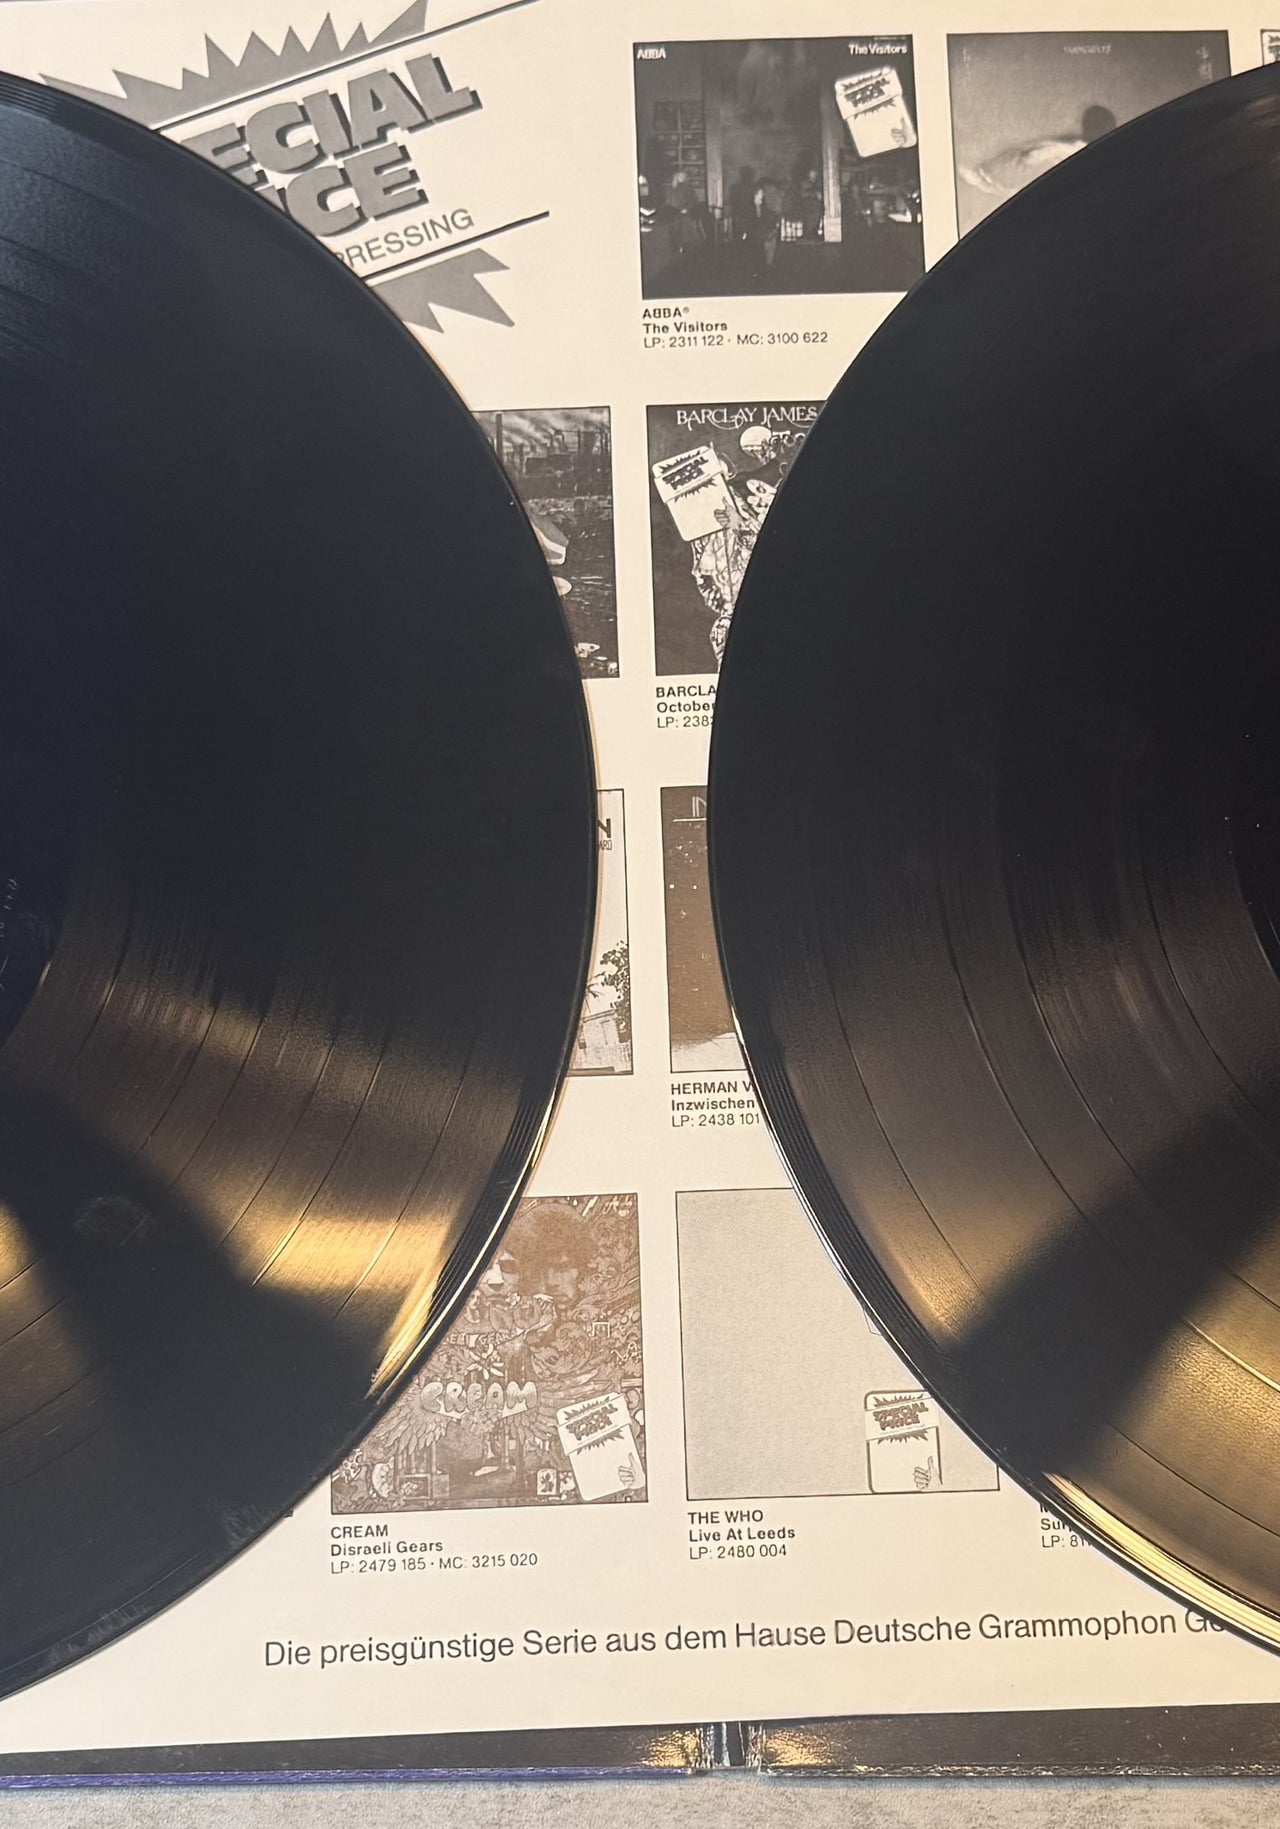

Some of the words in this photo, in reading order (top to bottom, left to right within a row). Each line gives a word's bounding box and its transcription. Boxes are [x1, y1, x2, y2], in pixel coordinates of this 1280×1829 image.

[180, 53, 483, 190] ECIAL
[643, 322, 669, 334] The
[674, 321, 728, 333] Visitors
[644, 337, 666, 349] LP:
[669, 336, 698, 347] 2311
[702, 335, 724, 346] 122
[737, 333, 764, 346] MC:
[767, 332, 799, 344] 3100
[803, 331, 828, 343] 622
[676, 406, 757, 431] BARCLAY
[656, 685, 717, 699] BARCLA
[657, 716, 679, 729] LP:
[671, 1082, 737, 1096] HERMAN
[671, 1096, 755, 1111] Inzwischen
[672, 1114, 695, 1127] LP:
[698, 1113, 735, 1126] 2438
[687, 1511, 720, 1524] THE
[725, 1510, 764, 1523] WHO
[331, 1525, 389, 1539] CREAM
[689, 1529, 721, 1542] Live
[726, 1528, 742, 1541] At
[747, 1526, 796, 1540] Leeds
[331, 1543, 391, 1556] Disraeli
[396, 1540, 443, 1553] Gears
[1041, 1535, 1065, 1548] LP:
[689, 1546, 713, 1560] LP:
[717, 1545, 755, 1559] 2480
[759, 1544, 787, 1557] 004
[331, 1561, 354, 1574] LP:
[359, 1559, 396, 1573] 2479
[402, 1557, 426, 1570] 185
[439, 1556, 467, 1569] MC:
[472, 1555, 506, 1568] 3215
[510, 1553, 538, 1566] 020
[265, 1641, 311, 1666] Die
[320, 1631, 515, 1669] preisgünstige
[523, 1628, 597, 1656] Serie
[605, 1629, 657, 1653] aus
[665, 1624, 727, 1651] dem
[736, 1621, 826, 1648] Hause
[834, 1615, 972, 1645] Deutsche
[979, 1610, 1177, 1641] Grammophon
